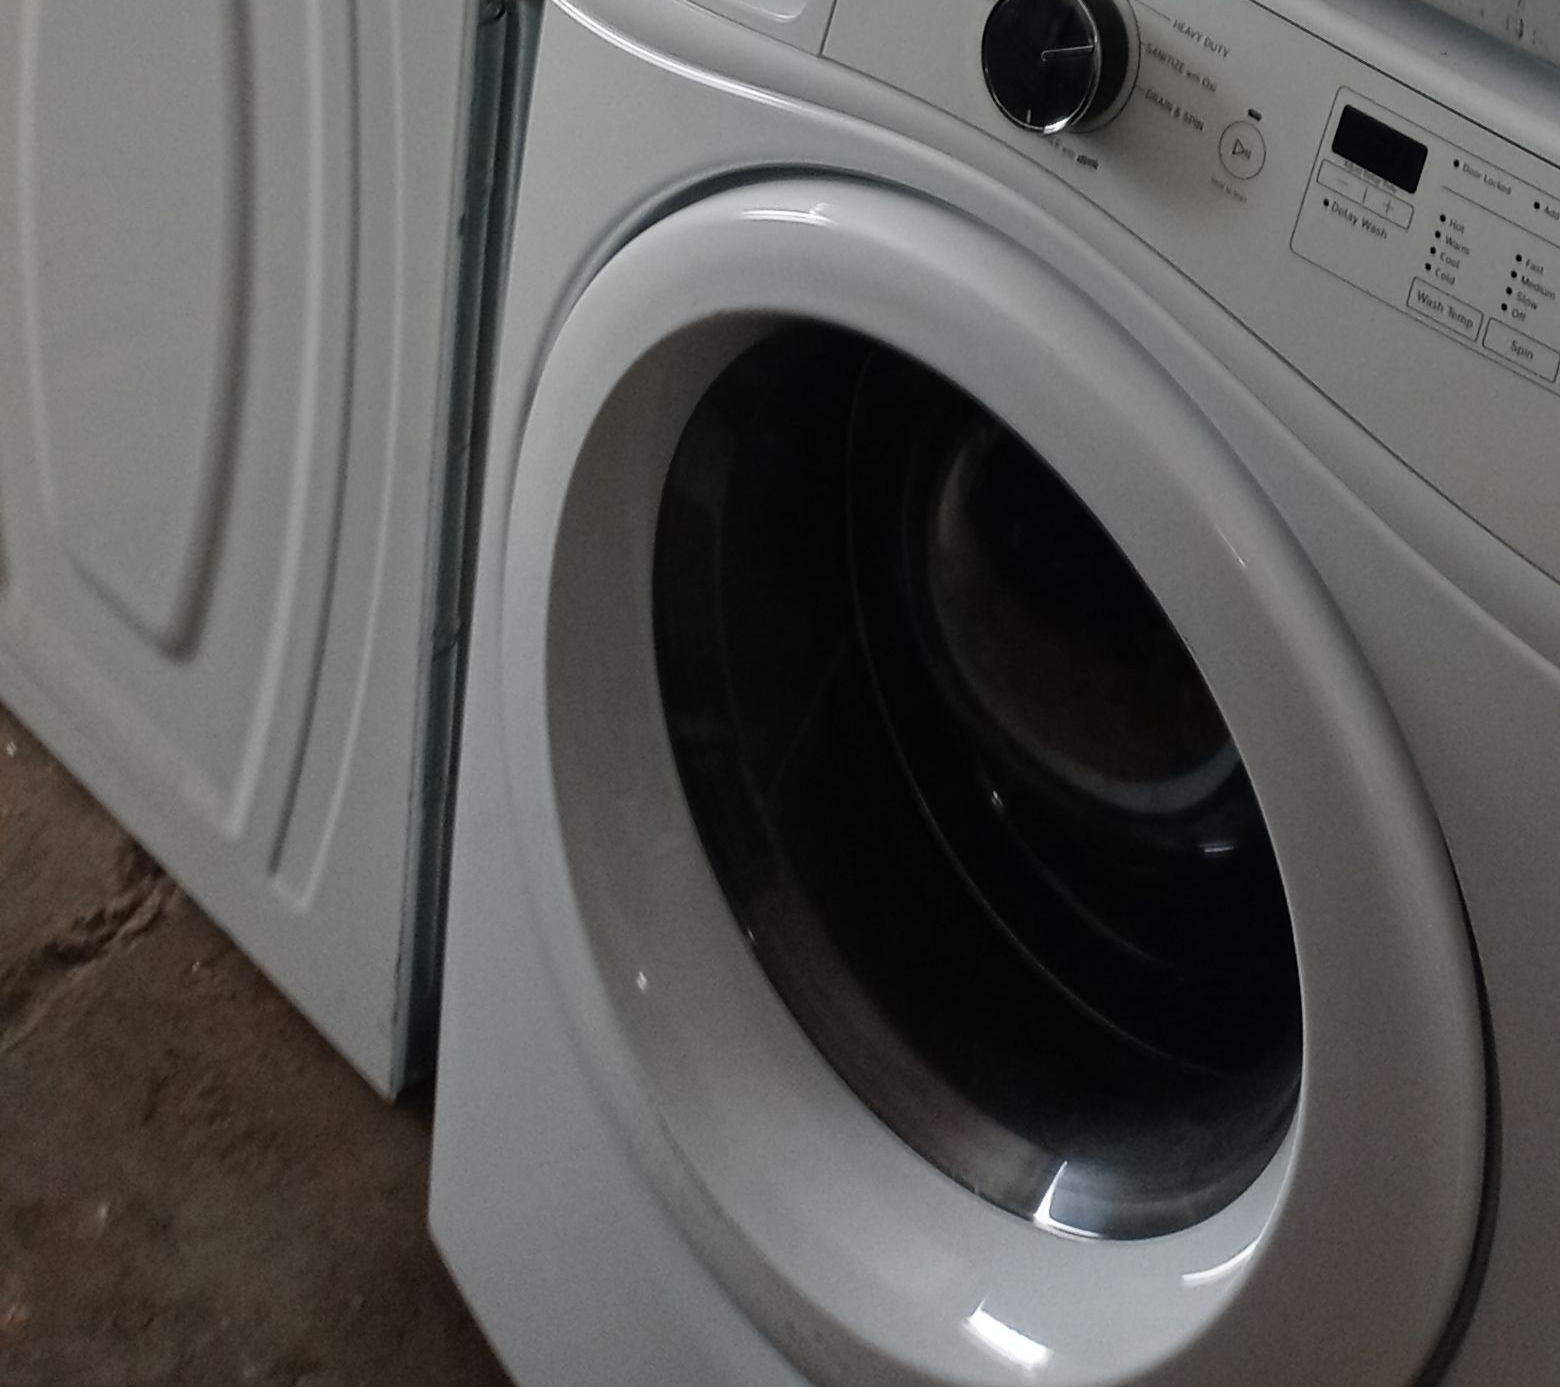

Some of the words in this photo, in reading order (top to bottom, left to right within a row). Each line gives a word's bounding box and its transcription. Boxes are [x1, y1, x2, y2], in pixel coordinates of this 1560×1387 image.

[1173, 19, 1201, 43] HEAVY
[1203, 37, 1230, 57] DUTY
[1145, 43, 1186, 73] SANITIZE
[1145, 89, 1173, 114] DRAIN
[1484, 175, 1512, 195] Locked
[1331, 201, 1357, 225] Delay
[1361, 218, 1387, 239] Wash
[1544, 205, 1560, 221] Add
[1450, 219, 1465, 234] Hot
[1445, 235, 1470, 255] Warm
[1440, 252, 1460, 269] Cool
[1525, 259, 1544, 275] Fast
[1435, 268, 1456, 285] Cold
[1521, 275, 1555, 301] Medium
[1417, 290, 1444, 313] Wash
[1448, 306, 1473, 328] Temp
[1516, 292, 1537, 310] Slow
[1511, 308, 1526, 322] Off
[1510, 340, 1534, 359] Spin
